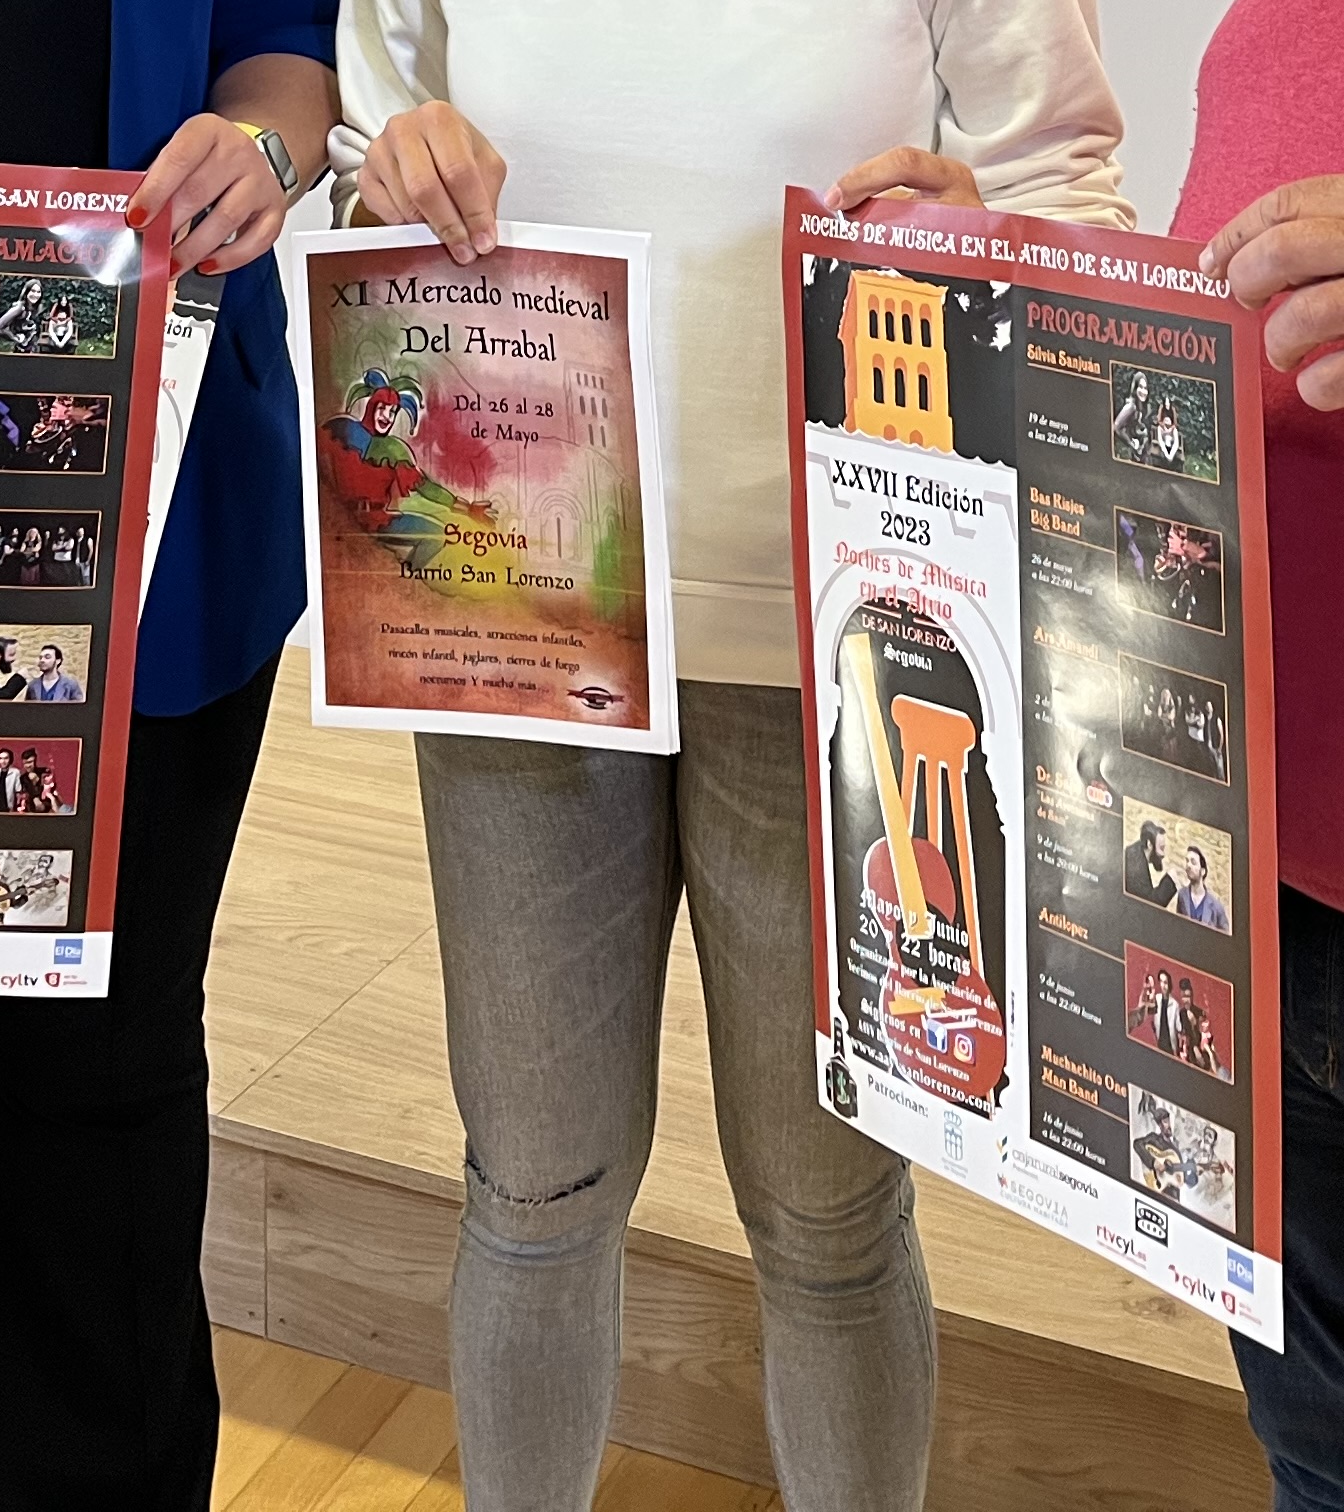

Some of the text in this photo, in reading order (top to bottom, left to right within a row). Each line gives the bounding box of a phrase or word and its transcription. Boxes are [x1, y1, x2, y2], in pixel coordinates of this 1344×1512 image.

[45, 190, 129, 213] LORENZ
[800, 213, 859, 242] NOCHES
[863, 222, 886, 246] DE
[889, 223, 957, 255] MÚSICA
[961, 235, 986, 258] EN
[990, 238, 1015, 262] EL
[1019, 242, 1069, 272] ATRIO
[1072, 250, 1097, 277] DE
[1100, 256, 1138, 284] SAN
[331, 276, 610, 321] XI Mercado medieval
[400, 324, 556, 361] Del Arrabal
[1027, 301, 1217, 365] PROGRAMACIÓN
[1027, 344, 1101, 375] Silvia Sanjuán
[453, 394, 554, 418] Del 26 al 28
[471, 422, 539, 449] de Mayo
[832, 459, 984, 517] XXVII Edición
[1030, 486, 1051, 506] Bas
[443, 523, 527, 556] Segovia
[881, 510, 931, 546] 2023
[1030, 509, 1080, 537] Big Band
[399, 561, 574, 591] Barrio San Lorenzo
[833, 541, 987, 599] Noches de Música
[859, 581, 952, 619] en el Atrio
[381, 623, 430, 636] Pasacalles
[862, 613, 957, 652] DE SAN LORENZO
[540, 656, 551, 668] de
[555, 658, 580, 675] fuego
[883, 642, 933, 672] Segovia
[471, 675, 479, 686] Y
[482, 677, 514, 688] mucho
[859, 888, 902, 920] Mayo
[926, 910, 969, 947] Junio
[859, 914, 878, 938] 20
[901, 934, 920, 958] 22
[928, 942, 971, 977] horas
[1041, 1044, 1127, 1098] Muchachito One
[1041, 1067, 1099, 1105] Man Band
[867, 1074, 929, 1118] Patrocinan:
[1010, 1179, 1068, 1220] SEGOVIA
